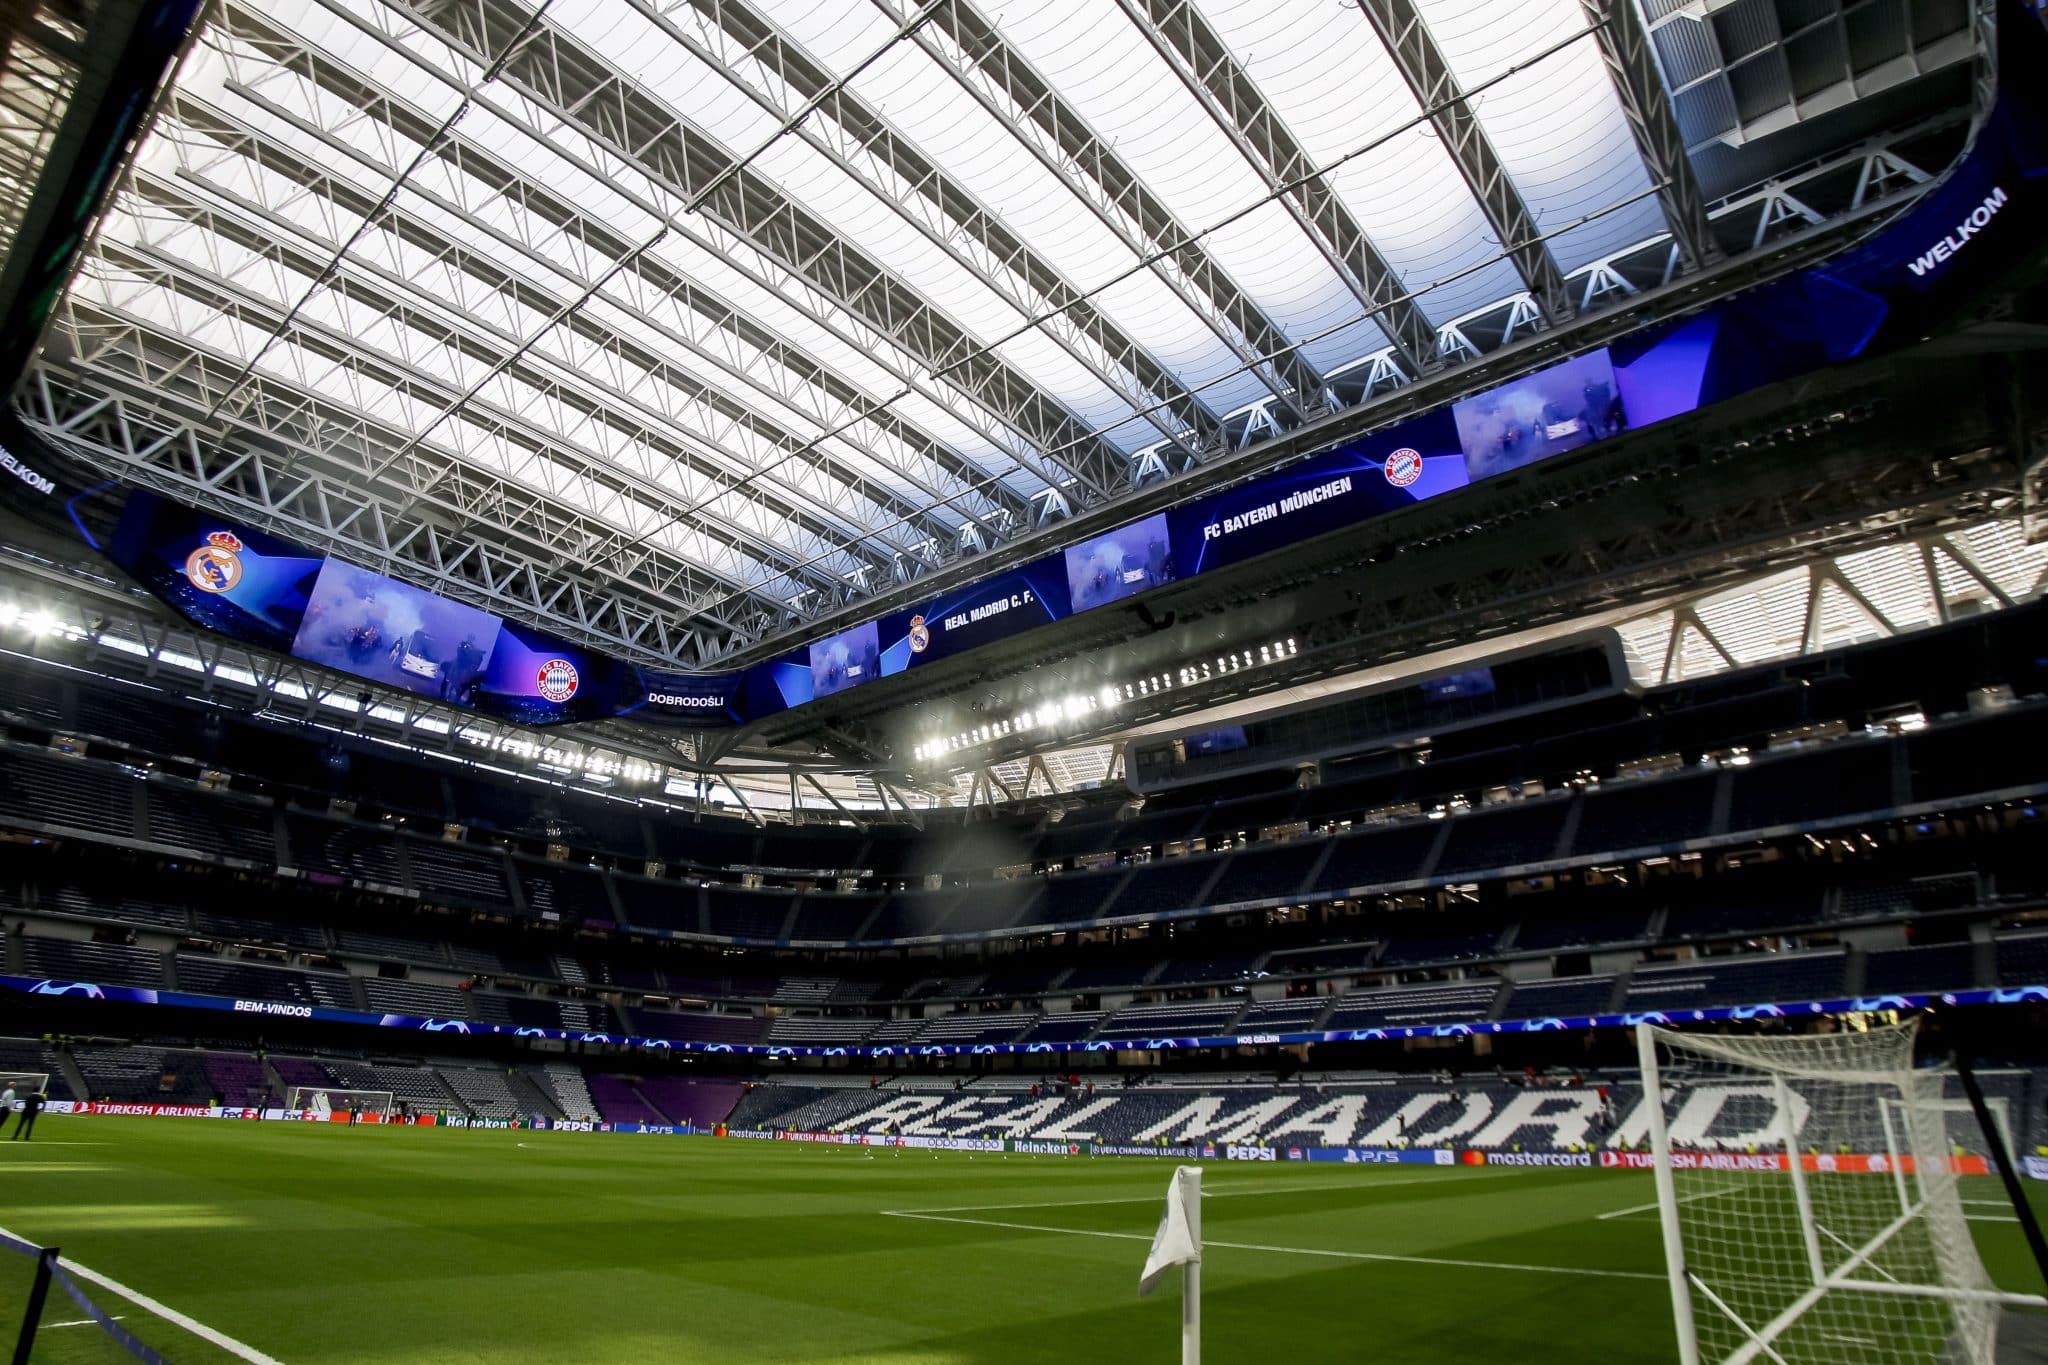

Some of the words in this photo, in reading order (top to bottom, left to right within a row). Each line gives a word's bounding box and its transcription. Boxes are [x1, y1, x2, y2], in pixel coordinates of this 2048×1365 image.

[1907, 186, 2008, 276] WELKOM
[1204, 523, 1221, 541] FC
[1224, 502, 1278, 534] BAYERN
[1280, 476, 1353, 515] MÜNCHEN
[945, 612, 969, 632] REAL
[971, 598, 1009, 622] MADRID
[1011, 594, 1021, 607] C.
[1023, 590, 1034, 603] F.
[648, 692, 724, 707] DOBRODOŠLI
[233, 1000, 313, 1018] BEM-VINDOS
[96, 1104, 153, 1116] TURKISH
[155, 1106, 211, 1118] AIRLINES
[221, 1107, 258, 1120] FedEx
[282, 1110, 318, 1122] FedEx
[831, 1096, 1120, 1139] REAL
[1132, 1086, 1811, 1149] MADRID
[446, 1116, 508, 1129] Heineken
[553, 1120, 593, 1132] PEPSI
[728, 1129, 773, 1140] mastercard
[785, 1132, 814, 1142] TURKISH
[1014, 1141, 1068, 1154] Heineken
[1100, 1146, 1118, 1155] UEFA
[1118, 1146, 1158, 1156] CHAMPIONS
[1159, 1147, 1186, 1157] LEAGUE
[1226, 1147, 1276, 1161] PEPSI
[1360, 1151, 1400, 1163] PS5
[1488, 1151, 1592, 1166] mastercard
[1699, 1155, 1779, 1170] AIRLINES
